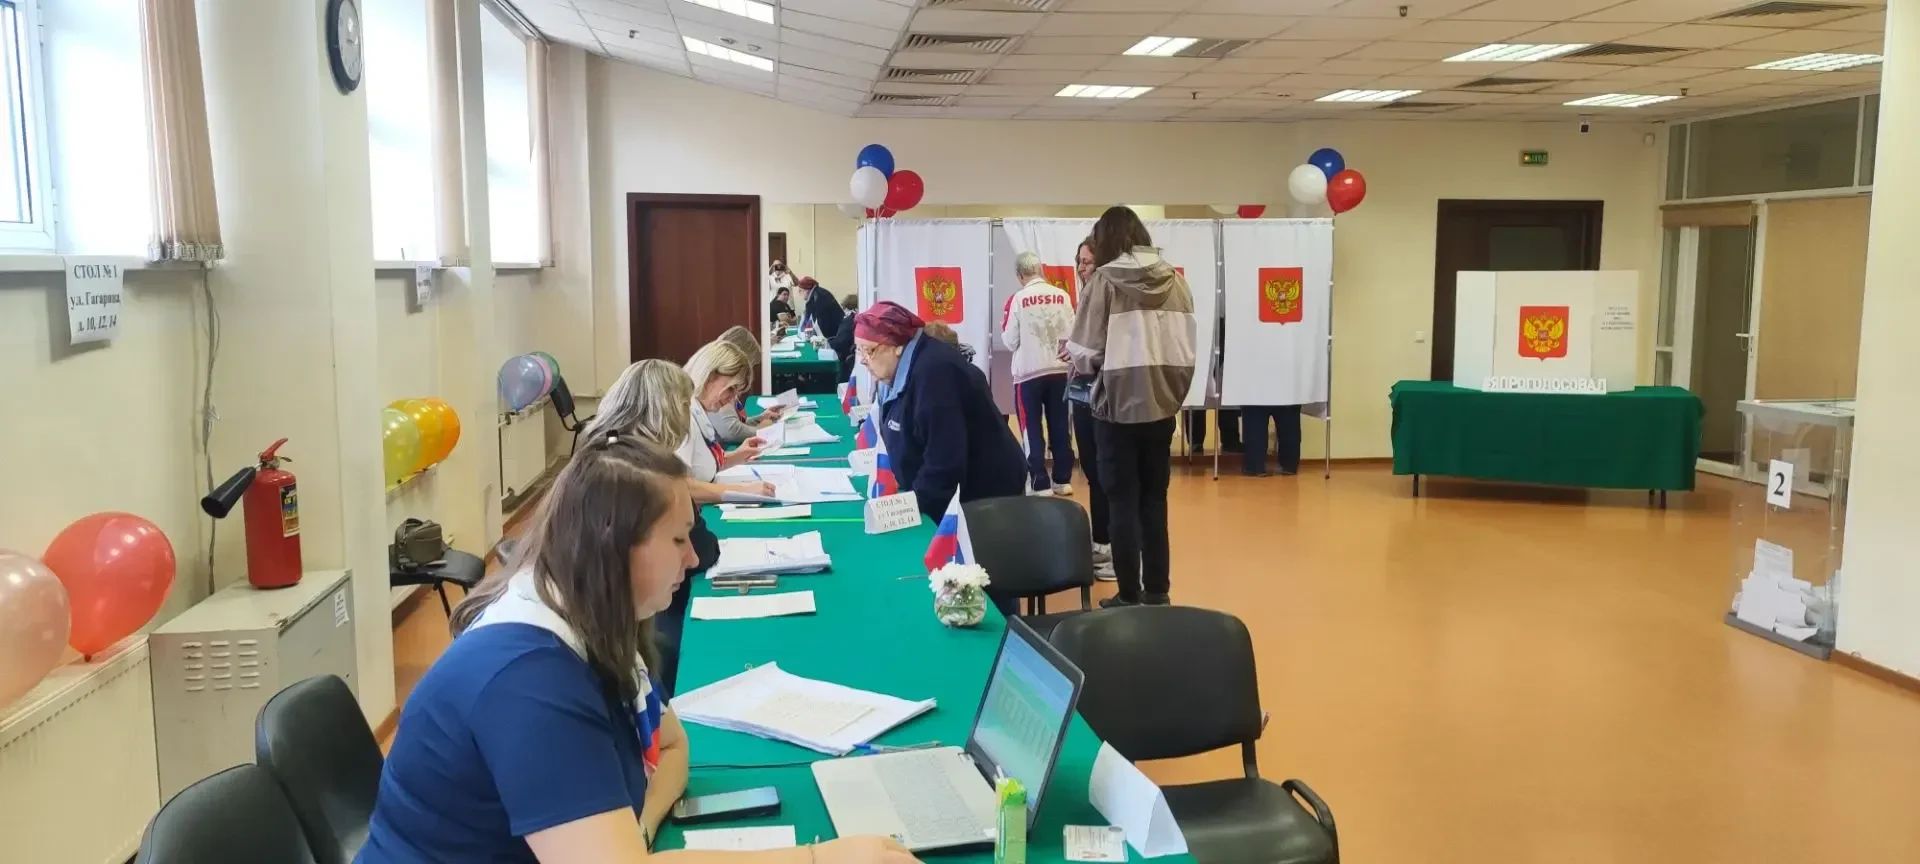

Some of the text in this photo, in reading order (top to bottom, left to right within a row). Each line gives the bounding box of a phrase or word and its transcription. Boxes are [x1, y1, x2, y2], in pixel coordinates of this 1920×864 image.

[74, 265, 118, 279] СТОЛ № 1
[70, 295, 84, 310] ул.
[1022, 294, 1065, 309] RUSSIA
[109, 314, 118, 328] 14
[1773, 471, 1785, 497] 2
